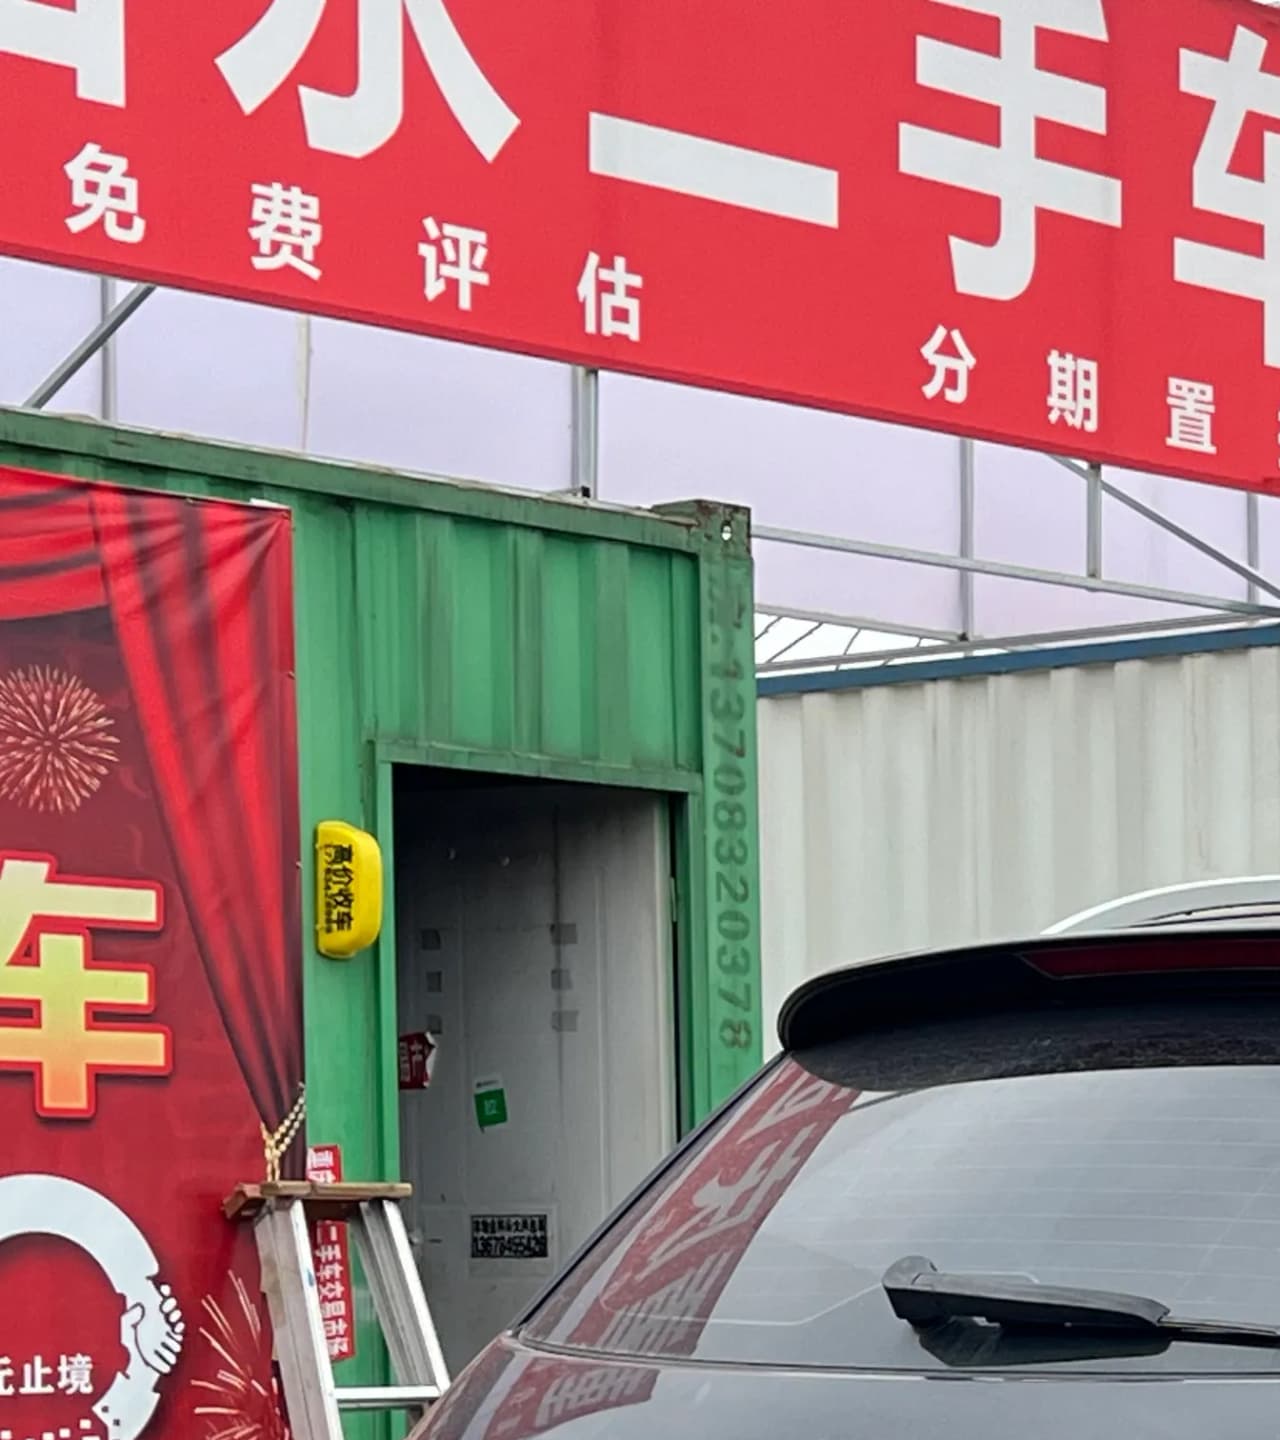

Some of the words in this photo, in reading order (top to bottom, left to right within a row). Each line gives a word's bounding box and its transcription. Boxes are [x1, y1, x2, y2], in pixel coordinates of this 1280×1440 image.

[63, 141, 645, 343] 免费评估
[322, 843, 354, 931] 高价收车
[709, 657, 753, 1050] 13708320378
